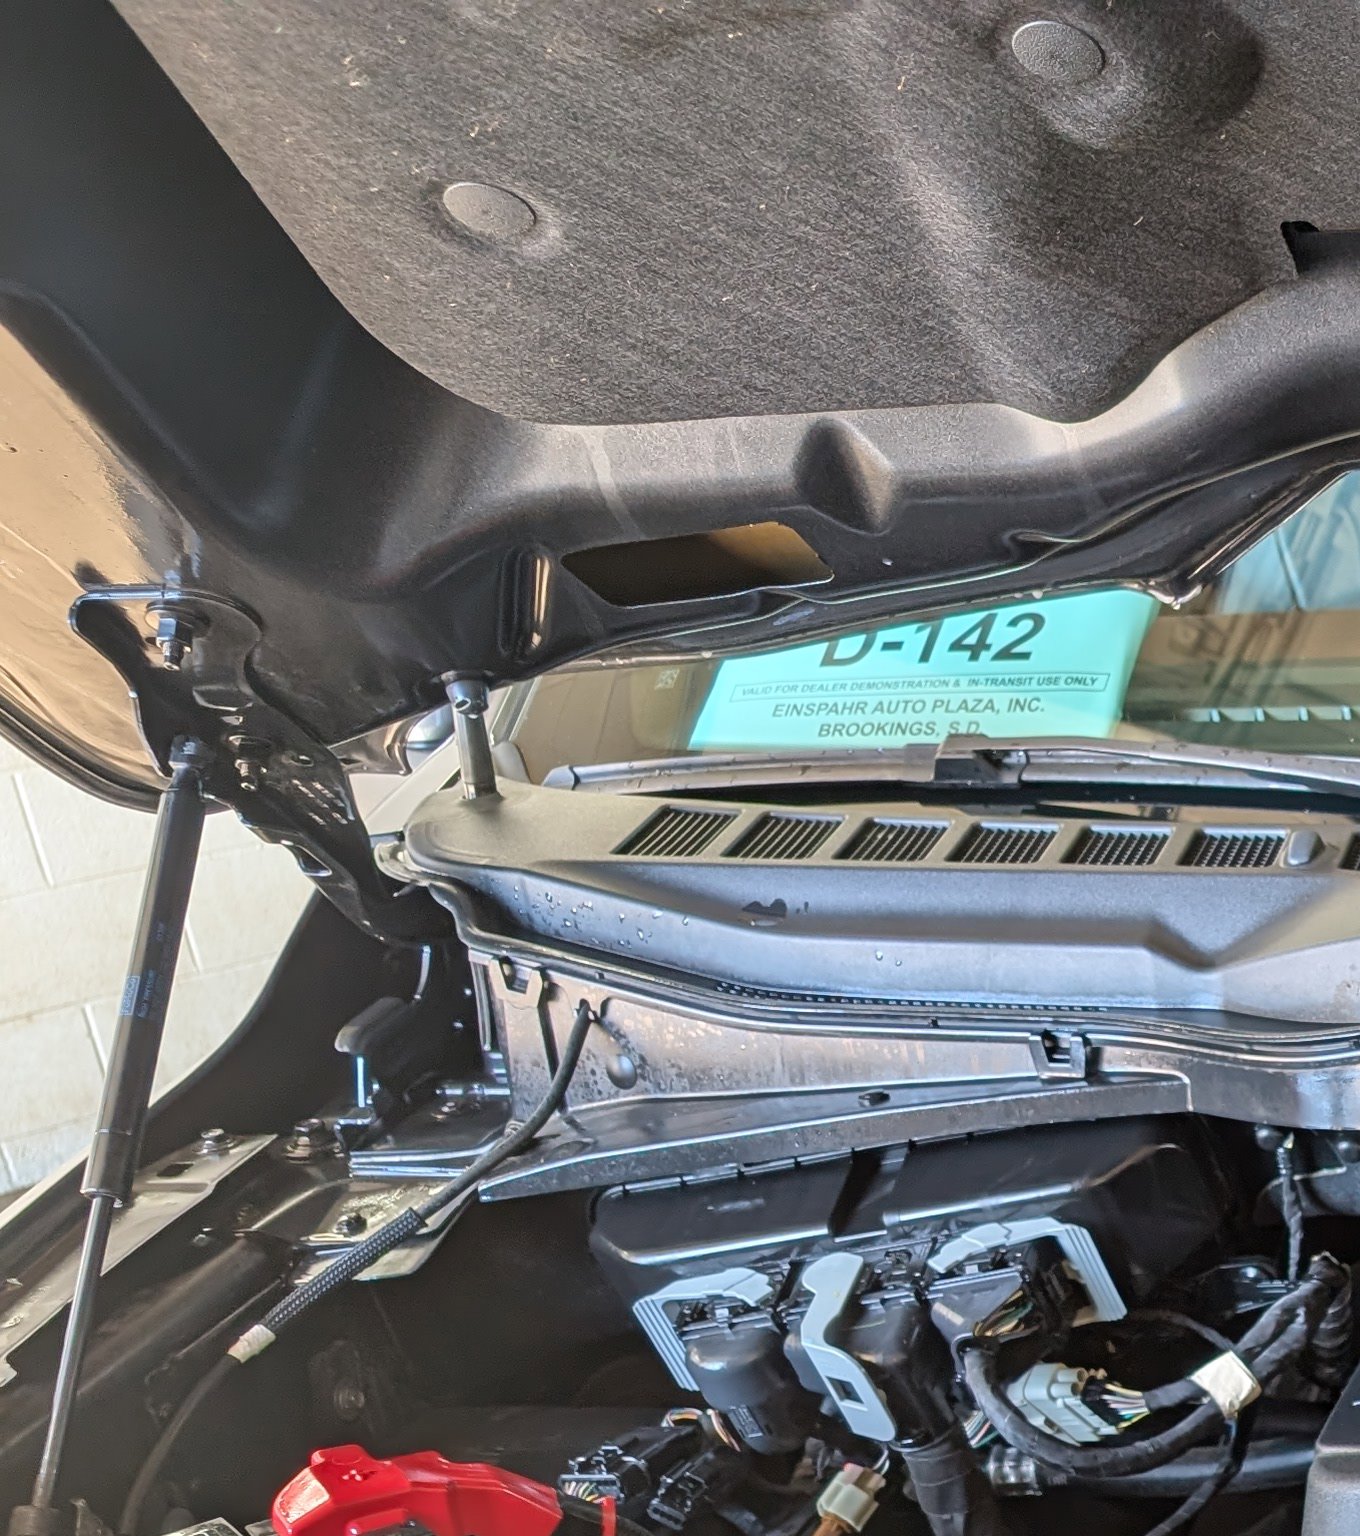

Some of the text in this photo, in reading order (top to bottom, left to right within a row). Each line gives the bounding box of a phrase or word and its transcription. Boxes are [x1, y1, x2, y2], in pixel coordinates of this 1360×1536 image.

[742, 675, 1099, 696] VALID FOR DEALER DEMONSTRATION & IN-TRANSIT USE ONLY
[772, 697, 1045, 718] EINSPAHR AUTO PLAZA, INC.
[818, 721, 940, 738] BROOKINGS,
